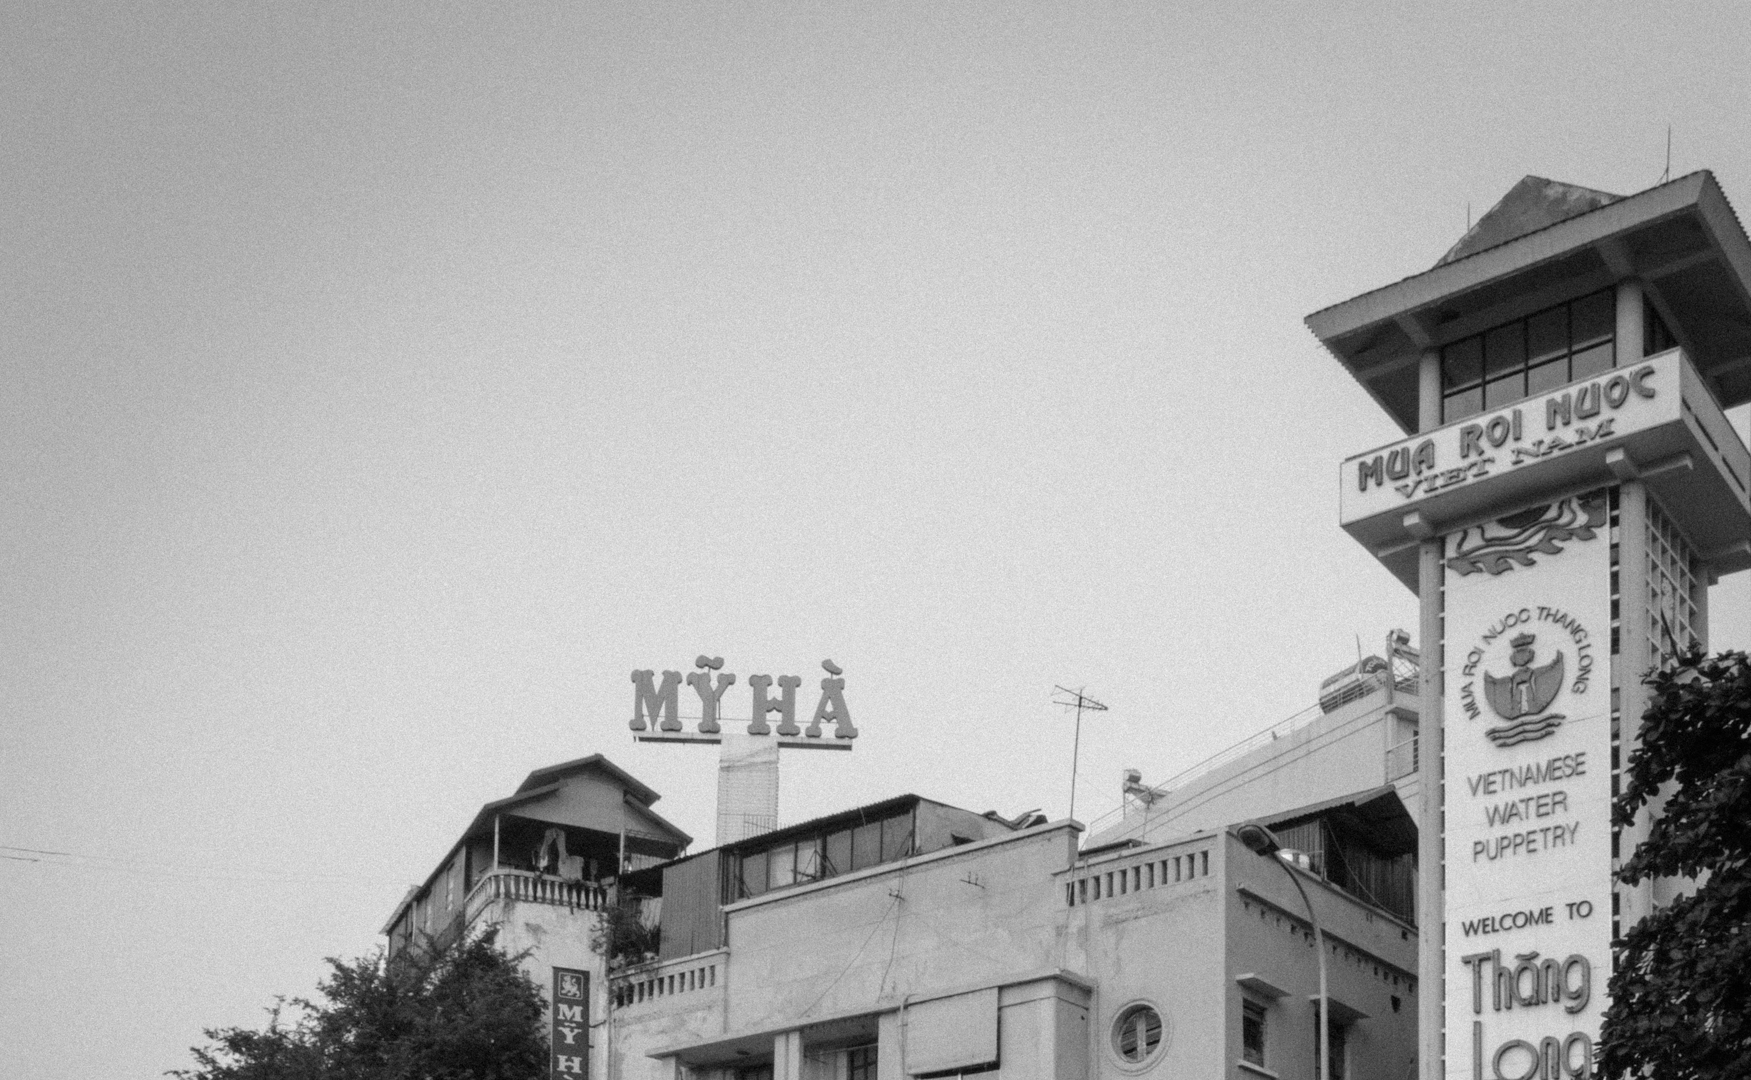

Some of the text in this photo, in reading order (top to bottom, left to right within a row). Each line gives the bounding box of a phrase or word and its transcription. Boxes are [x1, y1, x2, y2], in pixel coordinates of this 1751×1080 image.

[1358, 438, 1435, 492] MUA
[1459, 409, 1522, 459] ROI
[1394, 418, 1615, 499] VIET NAM
[1460, 606, 1594, 721] MUA ROI NUOC THANG LONG
[628, 654, 859, 739] MỸ HÀ
[1467, 752, 1587, 797] VIETNAMESE
[1485, 790, 1568, 827] WATER
[1473, 821, 1579, 863] PUPPETRY
[1461, 900, 1593, 938] WELCOME TO
[1461, 948, 1591, 1014] Thăng
[557, 1003, 584, 1045] MỸ
